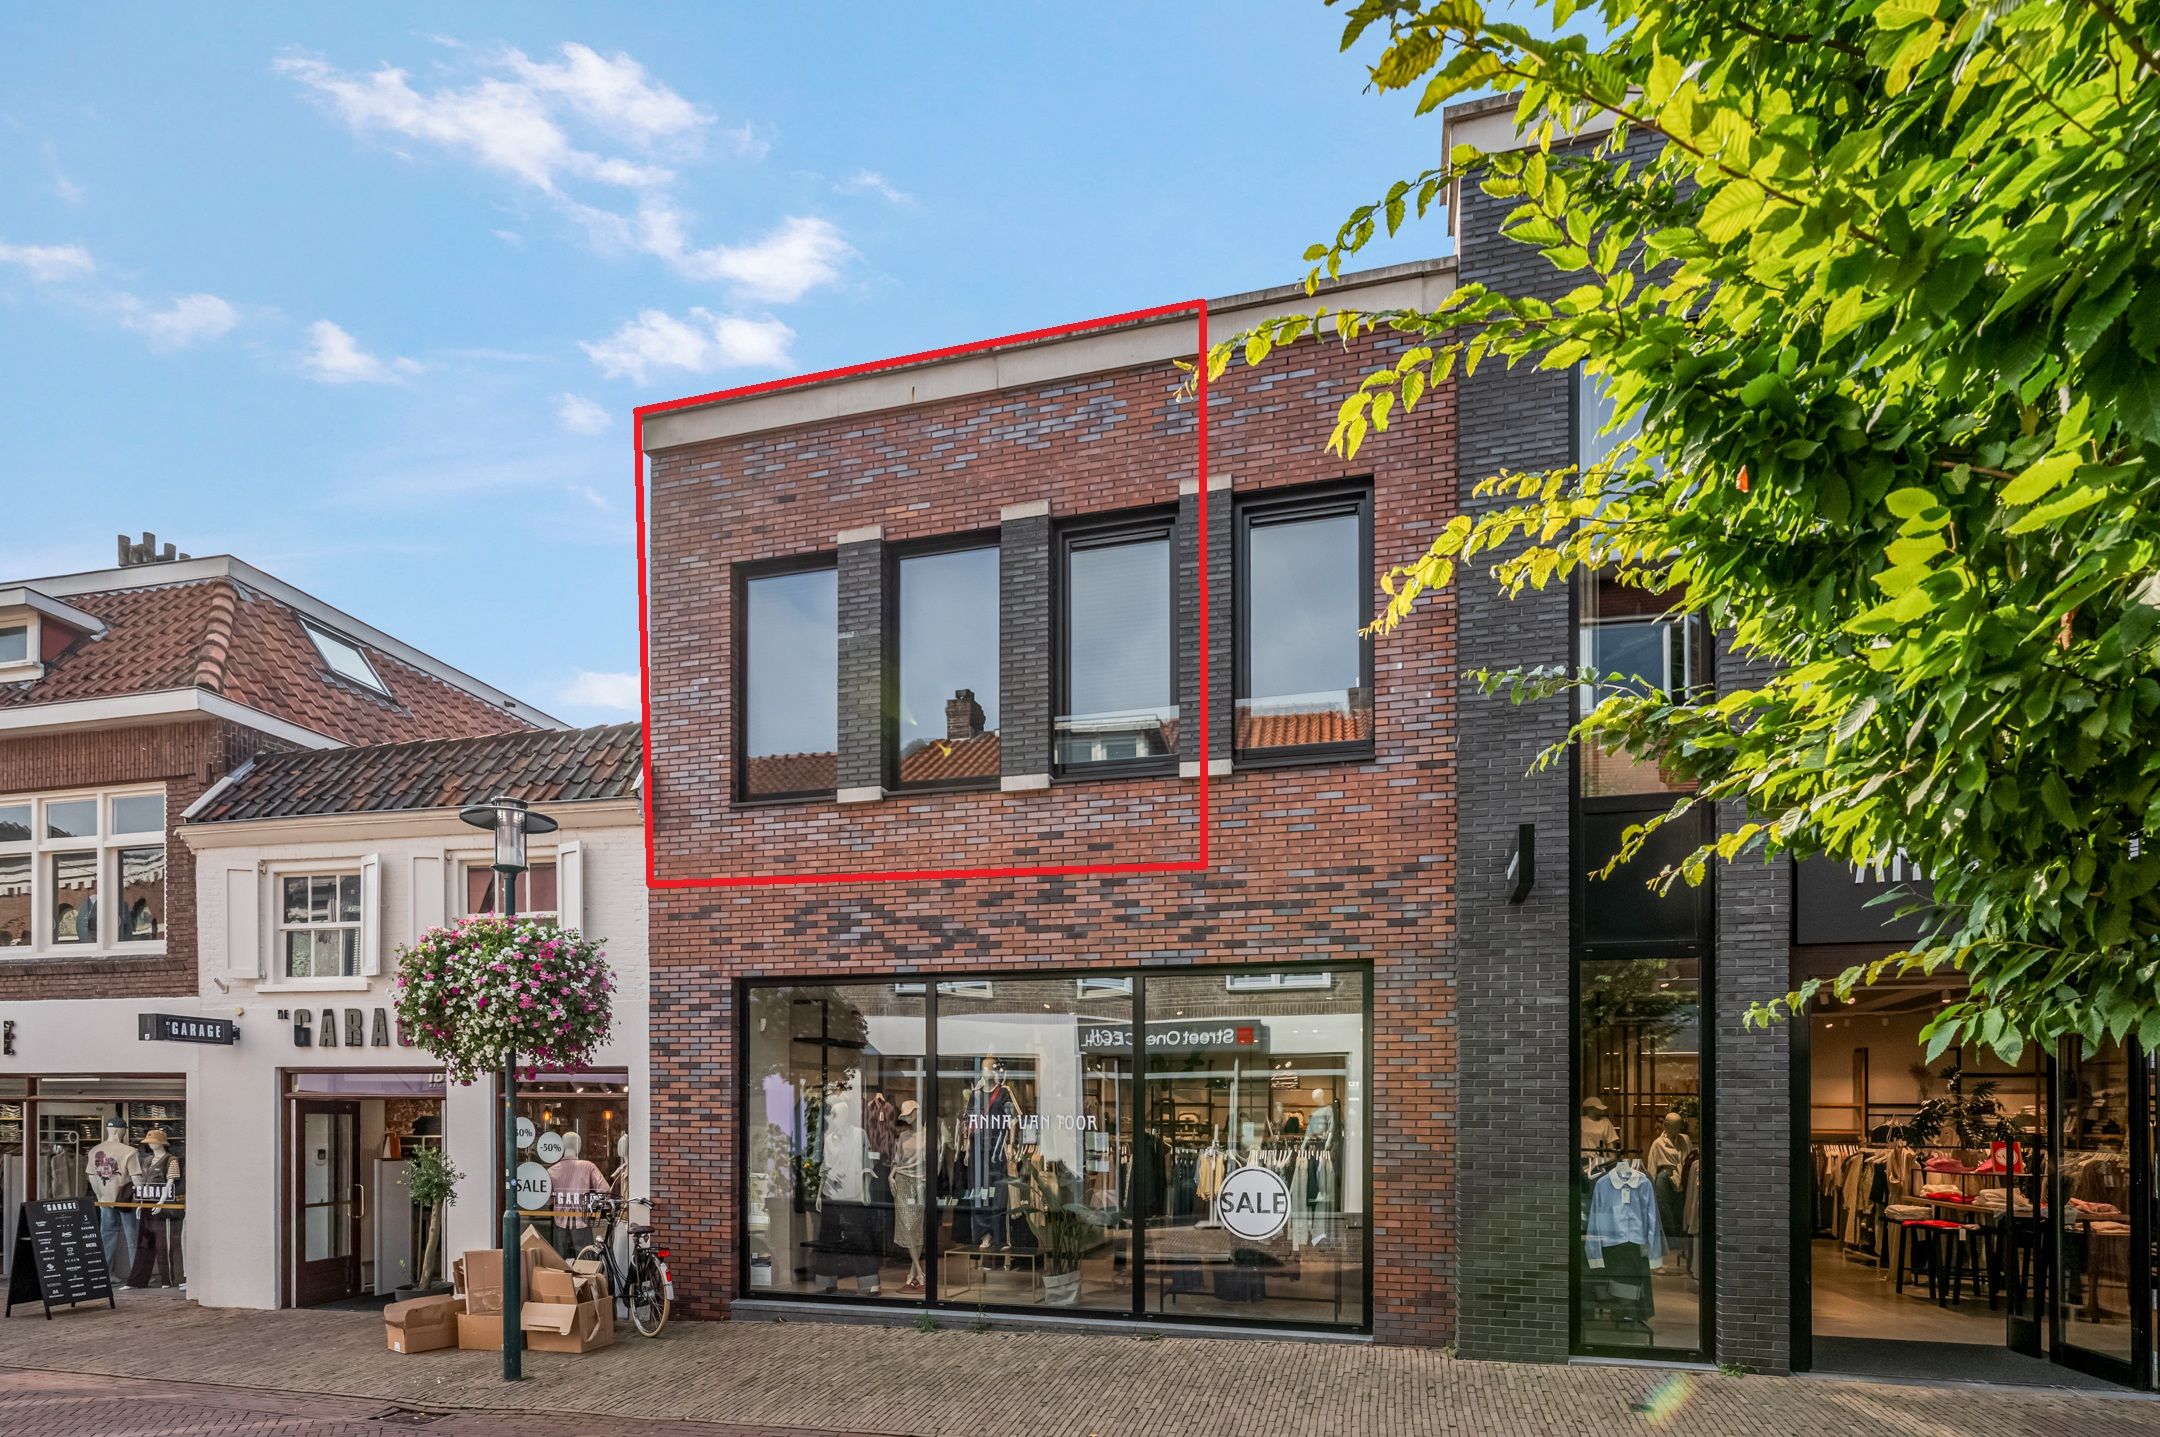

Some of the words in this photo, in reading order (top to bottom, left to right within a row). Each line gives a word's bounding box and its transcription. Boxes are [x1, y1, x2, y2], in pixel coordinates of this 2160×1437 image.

[277, 1009, 289, 1020] DE
[171, 1021, 221, 1038] GARAGE
[968, 1114, 1012, 1130] ANNA
[1017, 1114, 1050, 1130] VAN
[540, 1143, 562, 1152] -50%
[516, 1179, 547, 1193] SALE
[46, 1202, 77, 1212] GARAGE
[1220, 1191, 1287, 1214] SALE
